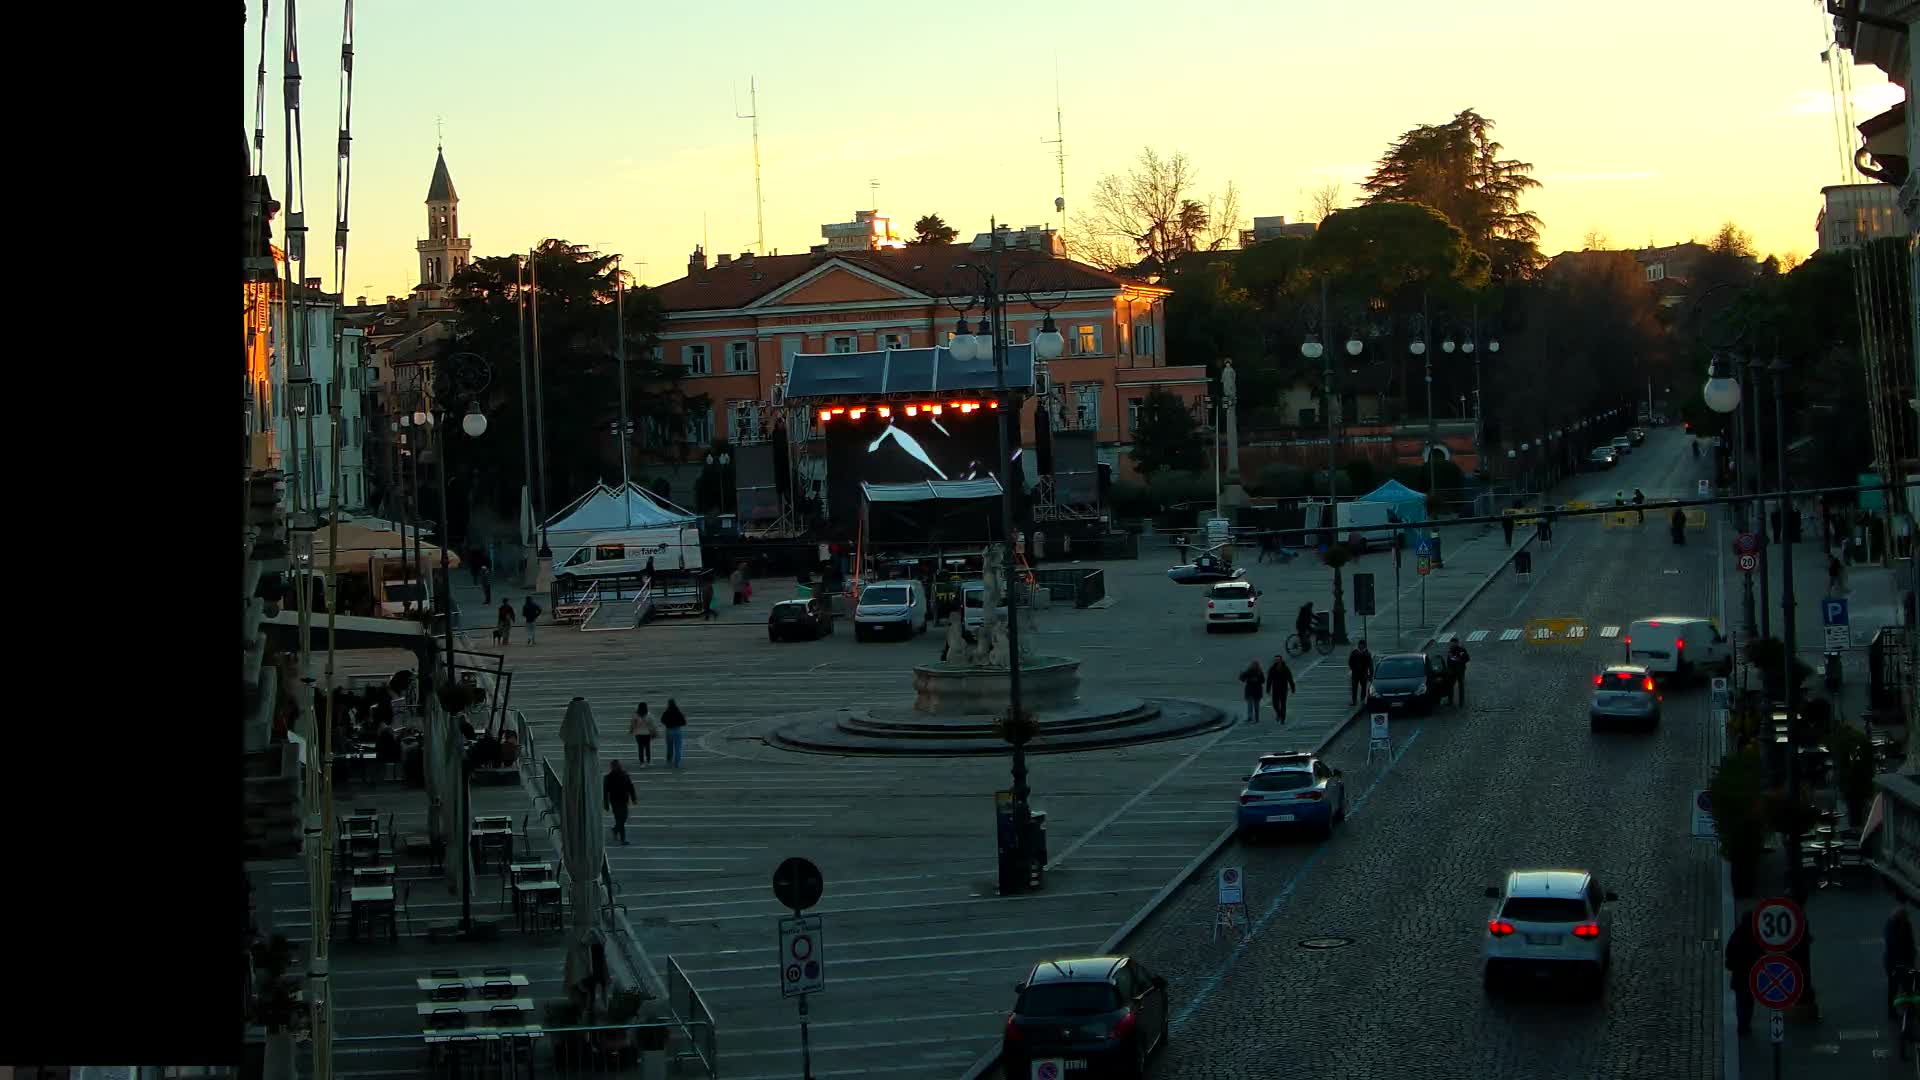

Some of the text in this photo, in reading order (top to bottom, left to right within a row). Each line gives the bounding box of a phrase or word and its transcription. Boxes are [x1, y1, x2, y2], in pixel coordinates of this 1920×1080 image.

[1742, 558, 1753, 568] 20
[1827, 602, 1842, 622] P
[1763, 911, 1792, 938] 30
